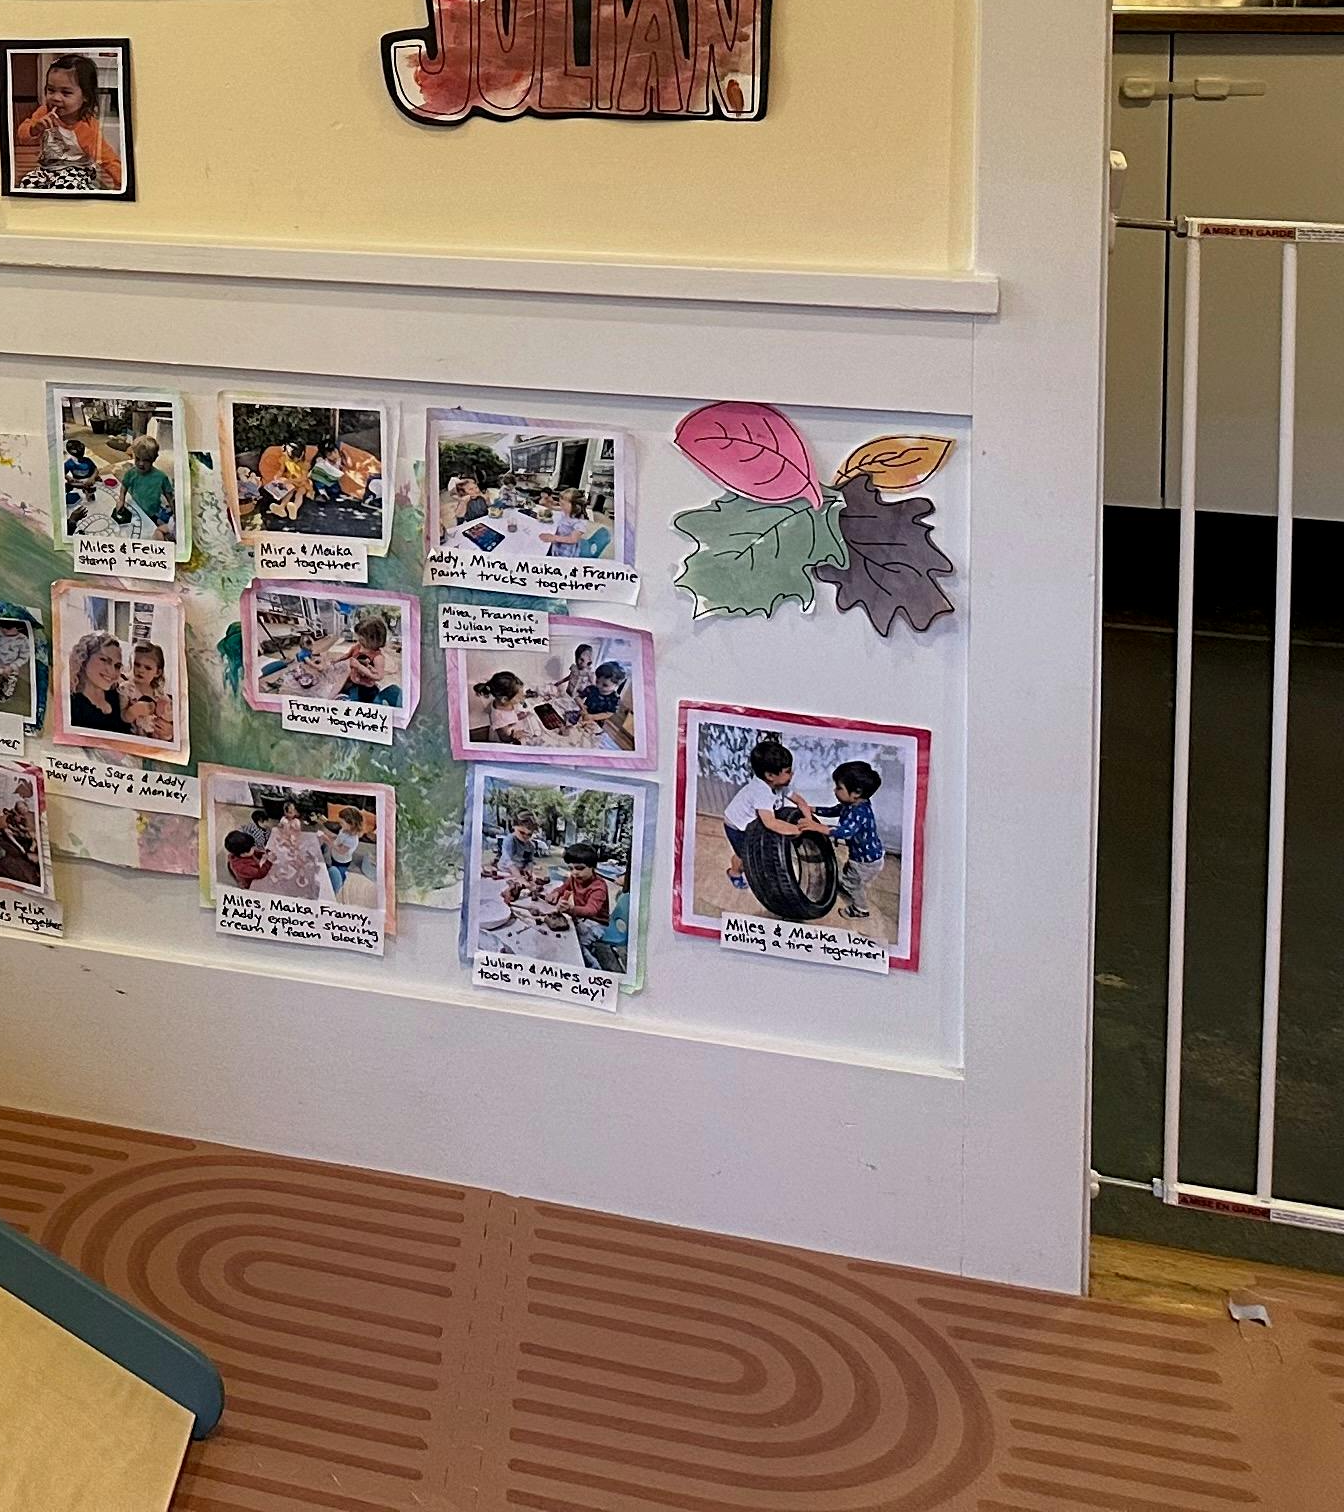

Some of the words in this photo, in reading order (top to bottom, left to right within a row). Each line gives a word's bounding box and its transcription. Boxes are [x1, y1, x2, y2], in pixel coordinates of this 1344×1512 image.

[79, 540, 115, 553] Miles
[120, 543, 127, 554] &
[132, 542, 165, 555] Felix
[260, 543, 296, 556] Mira
[300, 542, 307, 554] &
[311, 544, 352, 557] Maika
[78, 555, 117, 571] stamp
[261, 556, 287, 568] read
[431, 568, 467, 581] paint
[477, 571, 527, 586] trucks
[516, 562, 568, 580] Maika,
[583, 566, 638, 583] Frannie
[454, 621, 493, 632] Julian
[499, 625, 535, 635] paint
[443, 632, 488, 644] trains
[287, 711, 320, 724] draw
[288, 700, 338, 715] Frannie
[355, 707, 388, 723] Addy
[46, 756, 96, 774] Teacher
[105, 767, 134, 781] Sara
[156, 772, 186, 788] Addy
[46, 770, 68, 782] play
[14, 900, 45, 915] Felix
[222, 894, 265, 911] Miles,
[320, 906, 372, 926] Franny,
[220, 919, 264, 934] cream
[284, 926, 321, 940] foam
[232, 908, 262, 927] Addy
[267, 916, 315, 930] explore
[323, 921, 379, 943] shaving
[726, 919, 766, 935] Miles
[773, 924, 782, 938] &
[789, 927, 837, 943] Maika
[847, 933, 876, 948] love
[724, 934, 766, 951] rolling
[772, 940, 781, 948] a
[787, 940, 813, 952] tire
[820, 944, 886, 964] together!
[480, 956, 523, 971] Julian
[540, 966, 580, 982] Miles
[588, 975, 613, 988] use
[478, 969, 511, 983] tools
[518, 977, 530, 986] in
[536, 979, 563, 992] the
[571, 985, 605, 1003] clay!
